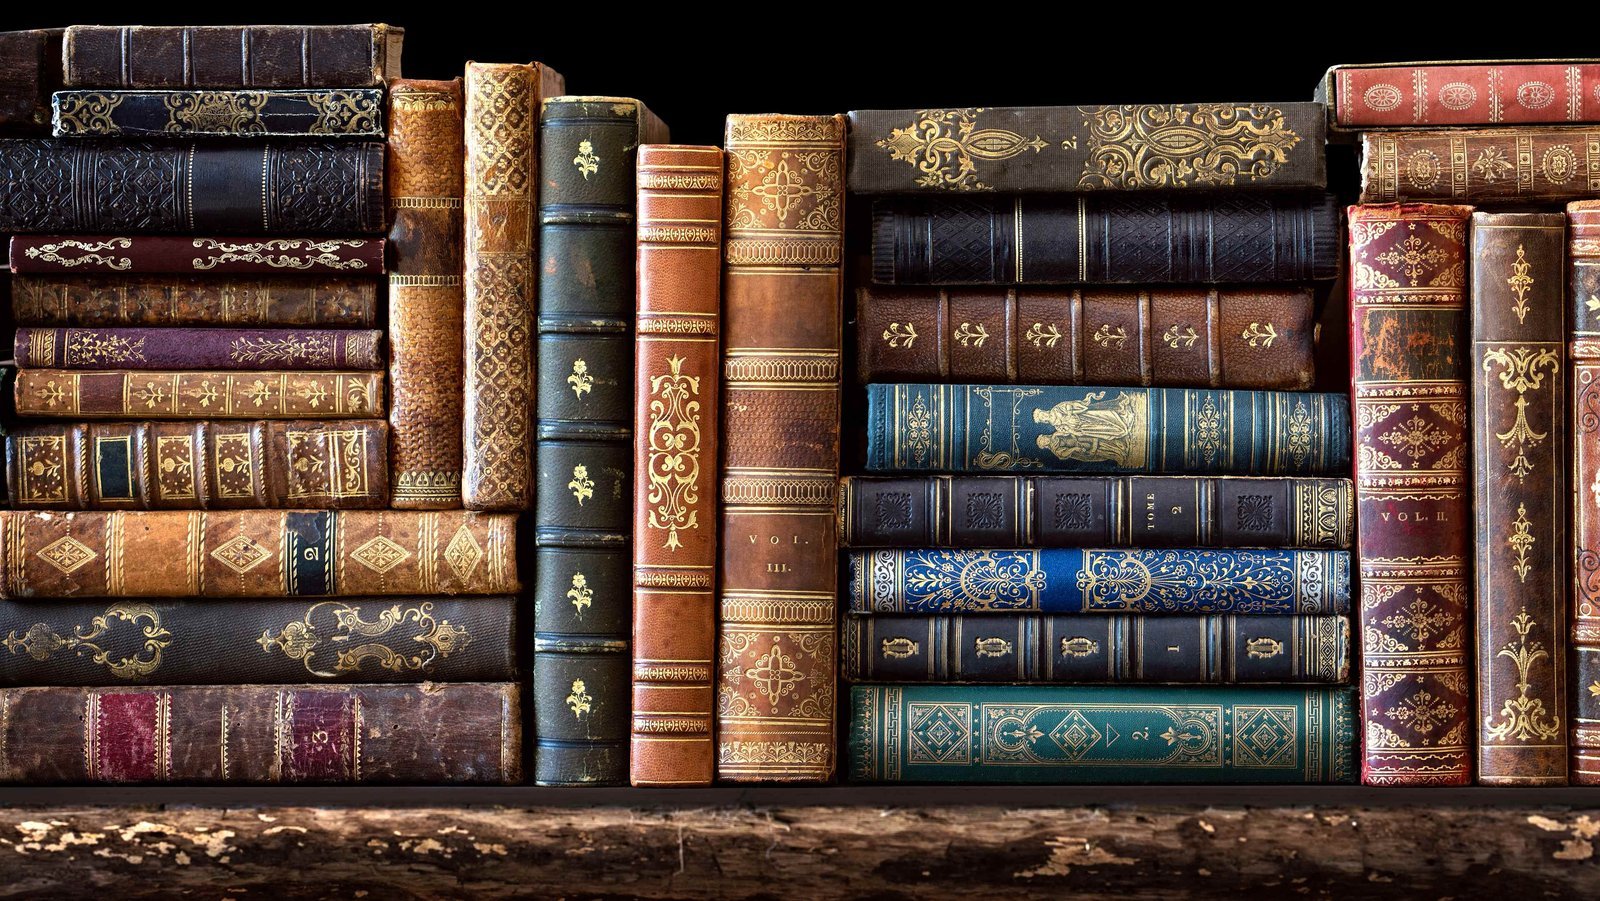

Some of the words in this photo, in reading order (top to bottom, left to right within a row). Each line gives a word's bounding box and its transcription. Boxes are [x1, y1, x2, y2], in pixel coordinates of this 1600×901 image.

[1061, 135, 1077, 150] 2.
[1146, 493, 1154, 531] TOME
[1171, 506, 1182, 515] 2
[1381, 511, 1428, 522] VOL.
[303, 547, 319, 561] 2
[766, 563, 792, 573] III.
